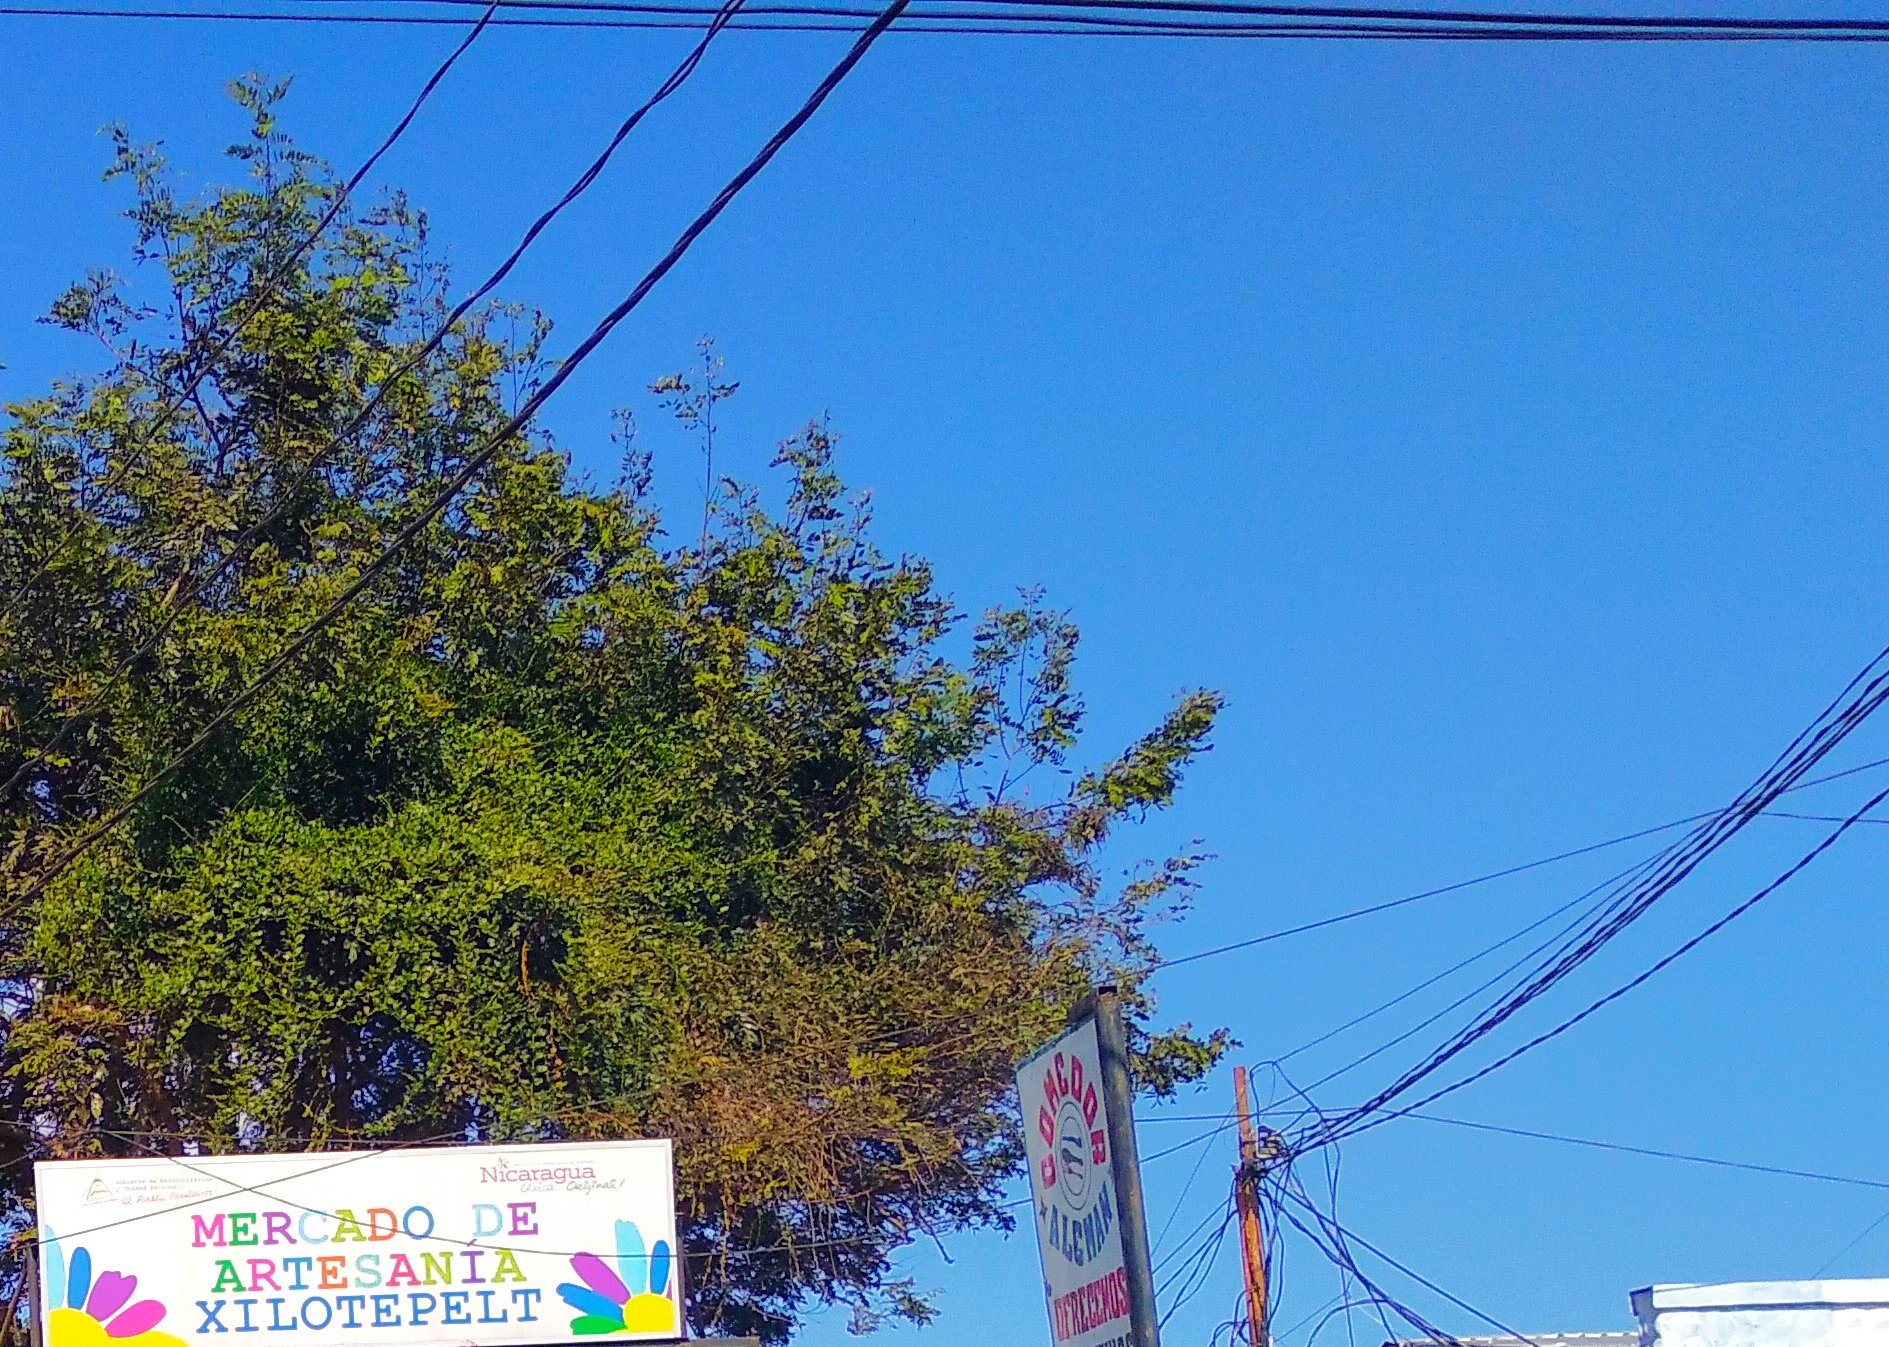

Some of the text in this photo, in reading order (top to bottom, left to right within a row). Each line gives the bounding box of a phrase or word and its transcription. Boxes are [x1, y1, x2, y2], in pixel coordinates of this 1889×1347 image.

[479, 1165, 597, 1185] Nicaragua
[191, 1201, 538, 1248] MERCADO DE
[211, 1249, 527, 1294] ARTESANIA
[194, 1288, 542, 1334] XILOTEPELT
[1054, 1266, 1131, 1341] OFRECEMOS
